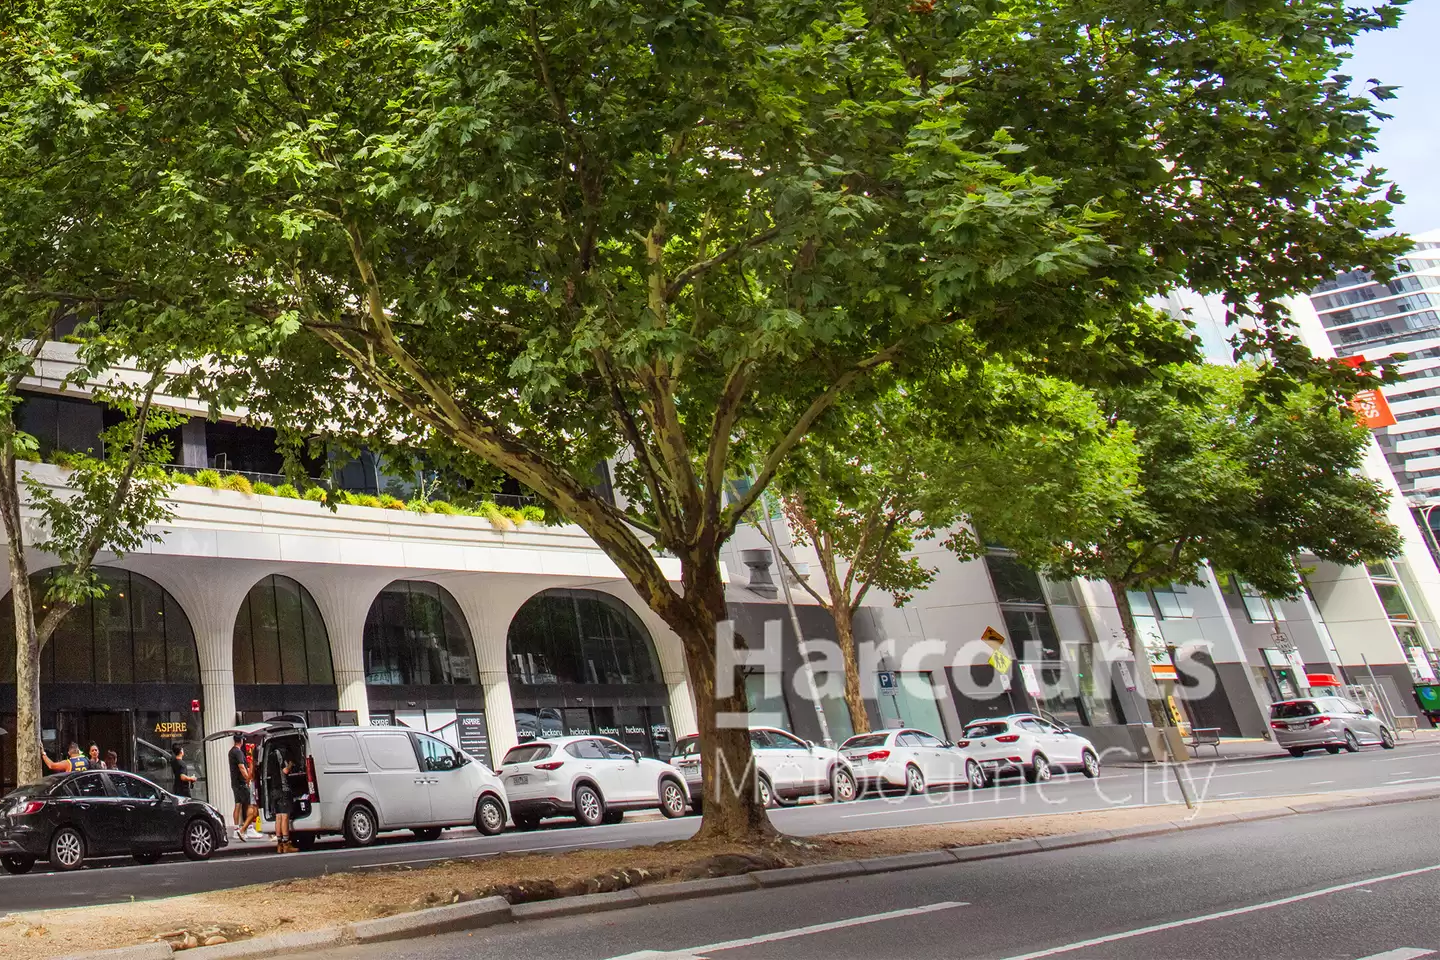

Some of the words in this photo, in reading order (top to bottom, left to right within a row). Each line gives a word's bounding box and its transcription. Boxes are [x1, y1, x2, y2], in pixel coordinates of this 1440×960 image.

[880, 675, 889, 686] P
[462, 718, 481, 726] ASPIRE
[155, 722, 188, 732] ASPIRE
[569, 727, 590, 736] hickory
[598, 726, 620, 736] hickory
[624, 726, 645, 736] hickory
[516, 729, 536, 738] ickory
[541, 728, 563, 737] hickory
